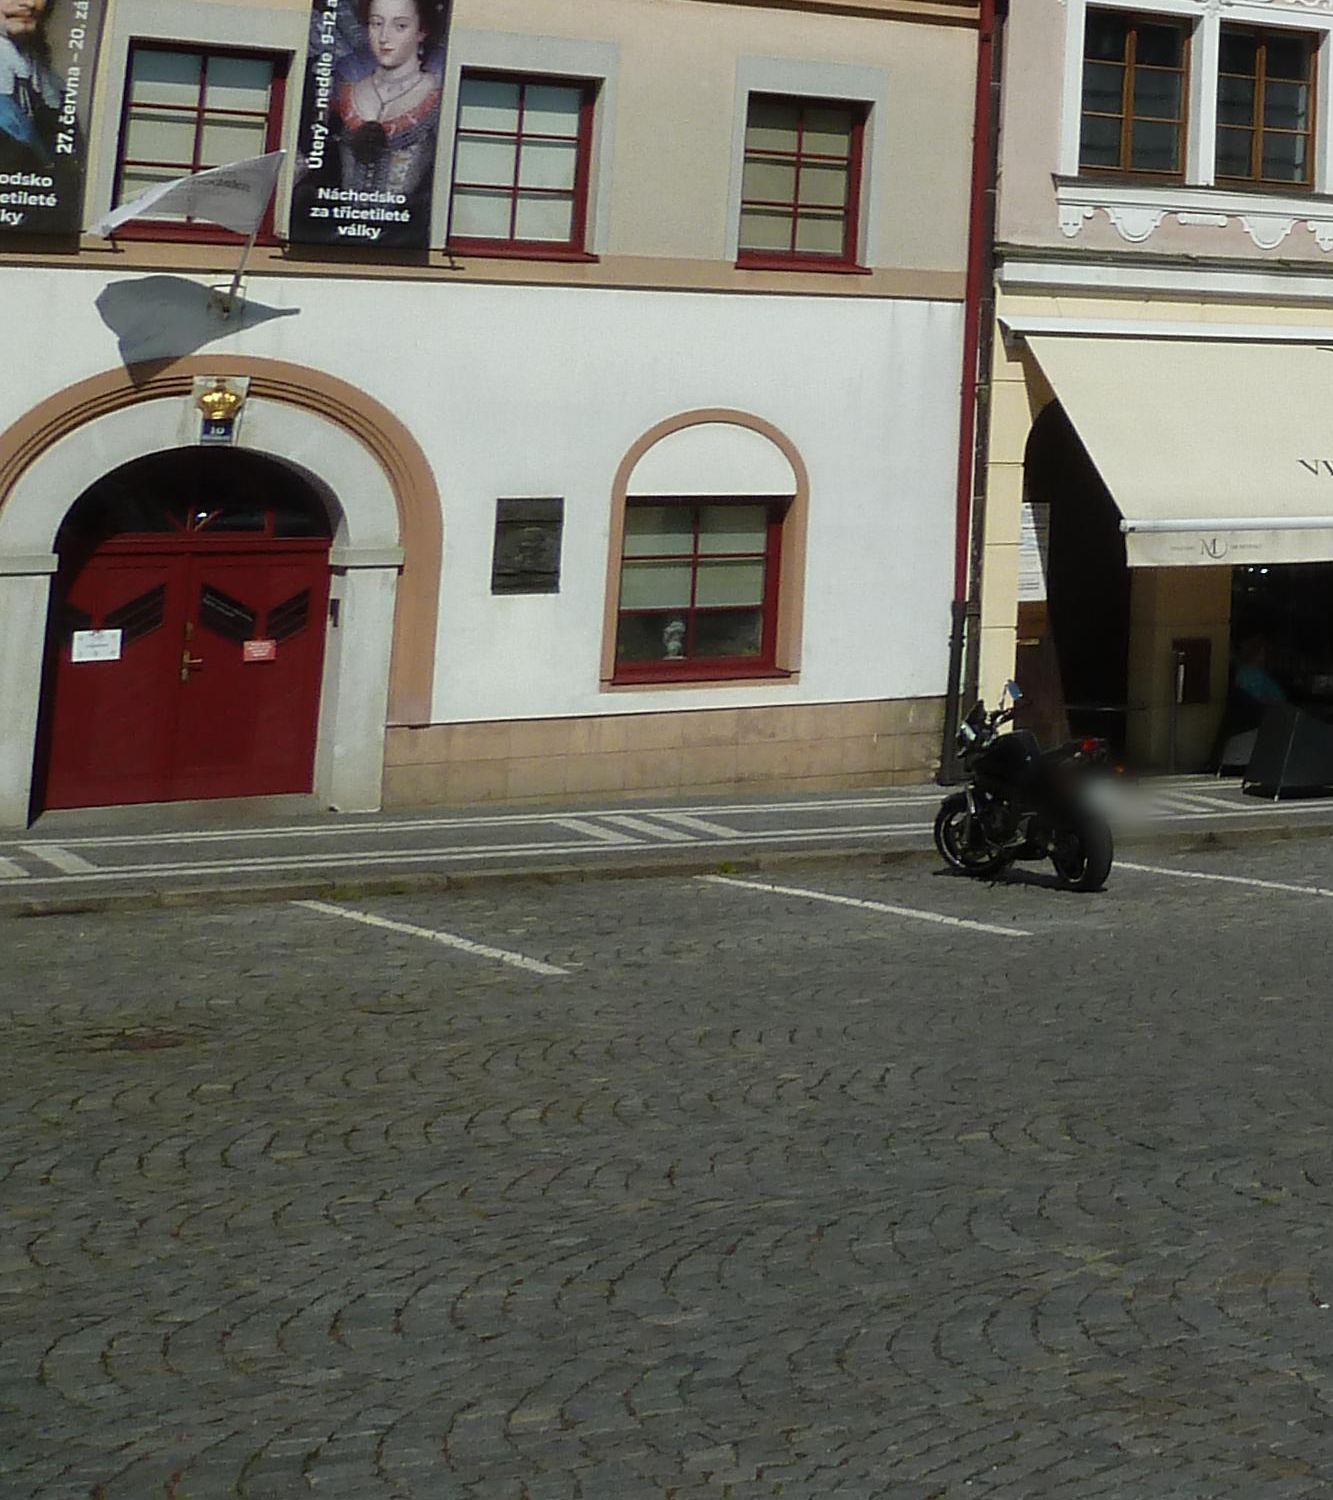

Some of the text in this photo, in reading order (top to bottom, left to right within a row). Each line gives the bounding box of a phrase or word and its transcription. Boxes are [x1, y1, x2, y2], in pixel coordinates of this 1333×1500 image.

[69, 24, 86, 50] 20.
[316, 52, 333, 108] neděle
[58, 67, 80, 125] června
[56, 129, 75, 154] 27.
[305, 123, 329, 169] Úterý
[0, 172, 52, 187] odsko
[0, 191, 57, 206] etileté
[318, 188, 406, 204] Náchodsko
[309, 206, 411, 222] za třicetileté
[338, 223, 381, 240] války
